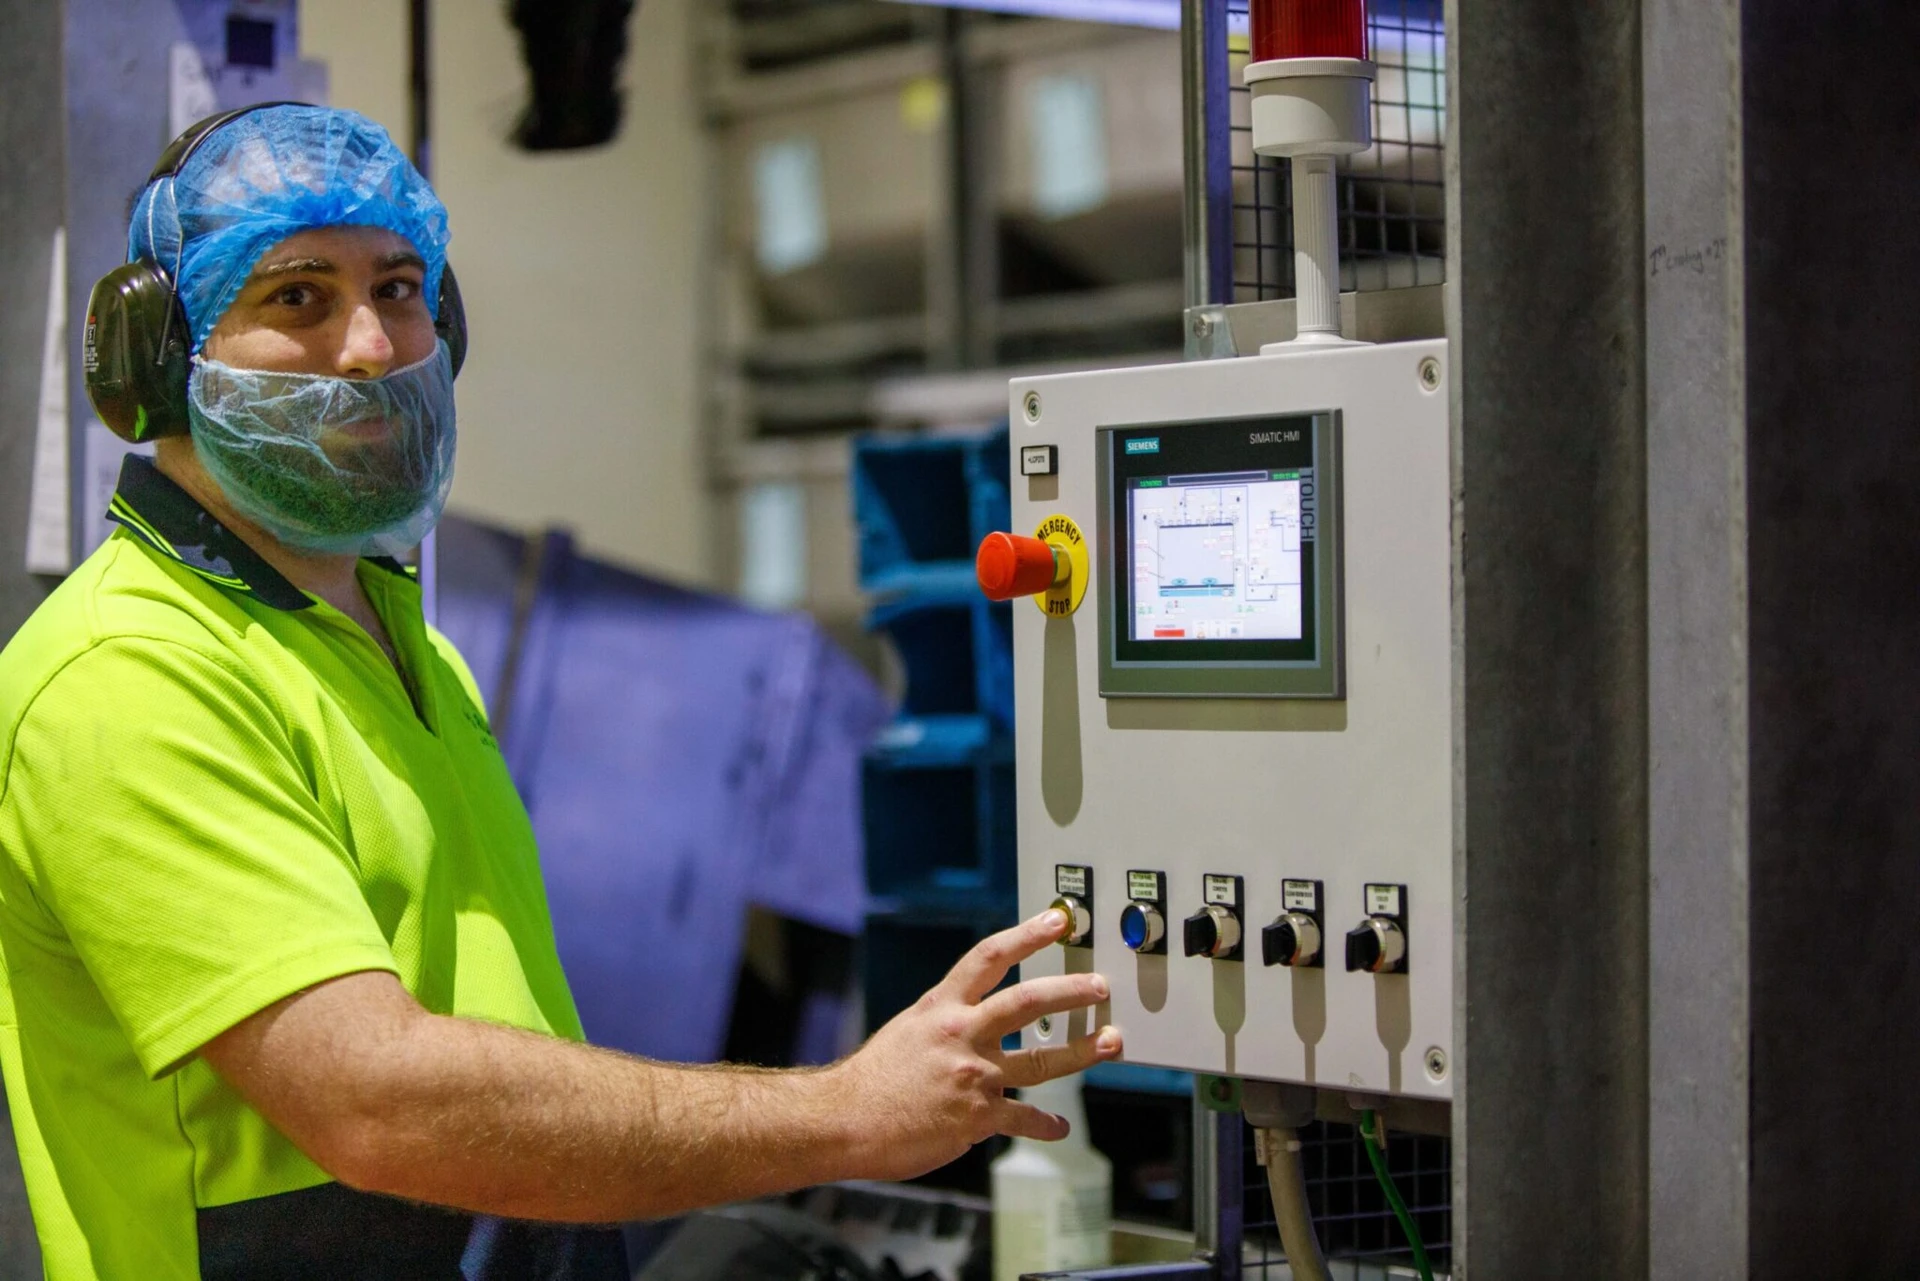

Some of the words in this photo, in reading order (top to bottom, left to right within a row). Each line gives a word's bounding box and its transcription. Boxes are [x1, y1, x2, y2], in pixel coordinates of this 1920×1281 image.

[1127, 440, 1158, 451] SIEMENS
[1249, 431, 1282, 444] SIMATIC
[1283, 430, 1300, 442] HMI
[1300, 469, 1315, 539] TOUCH
[1037, 518, 1081, 545] MERGENCY
[1048, 598, 1071, 615] STOP
